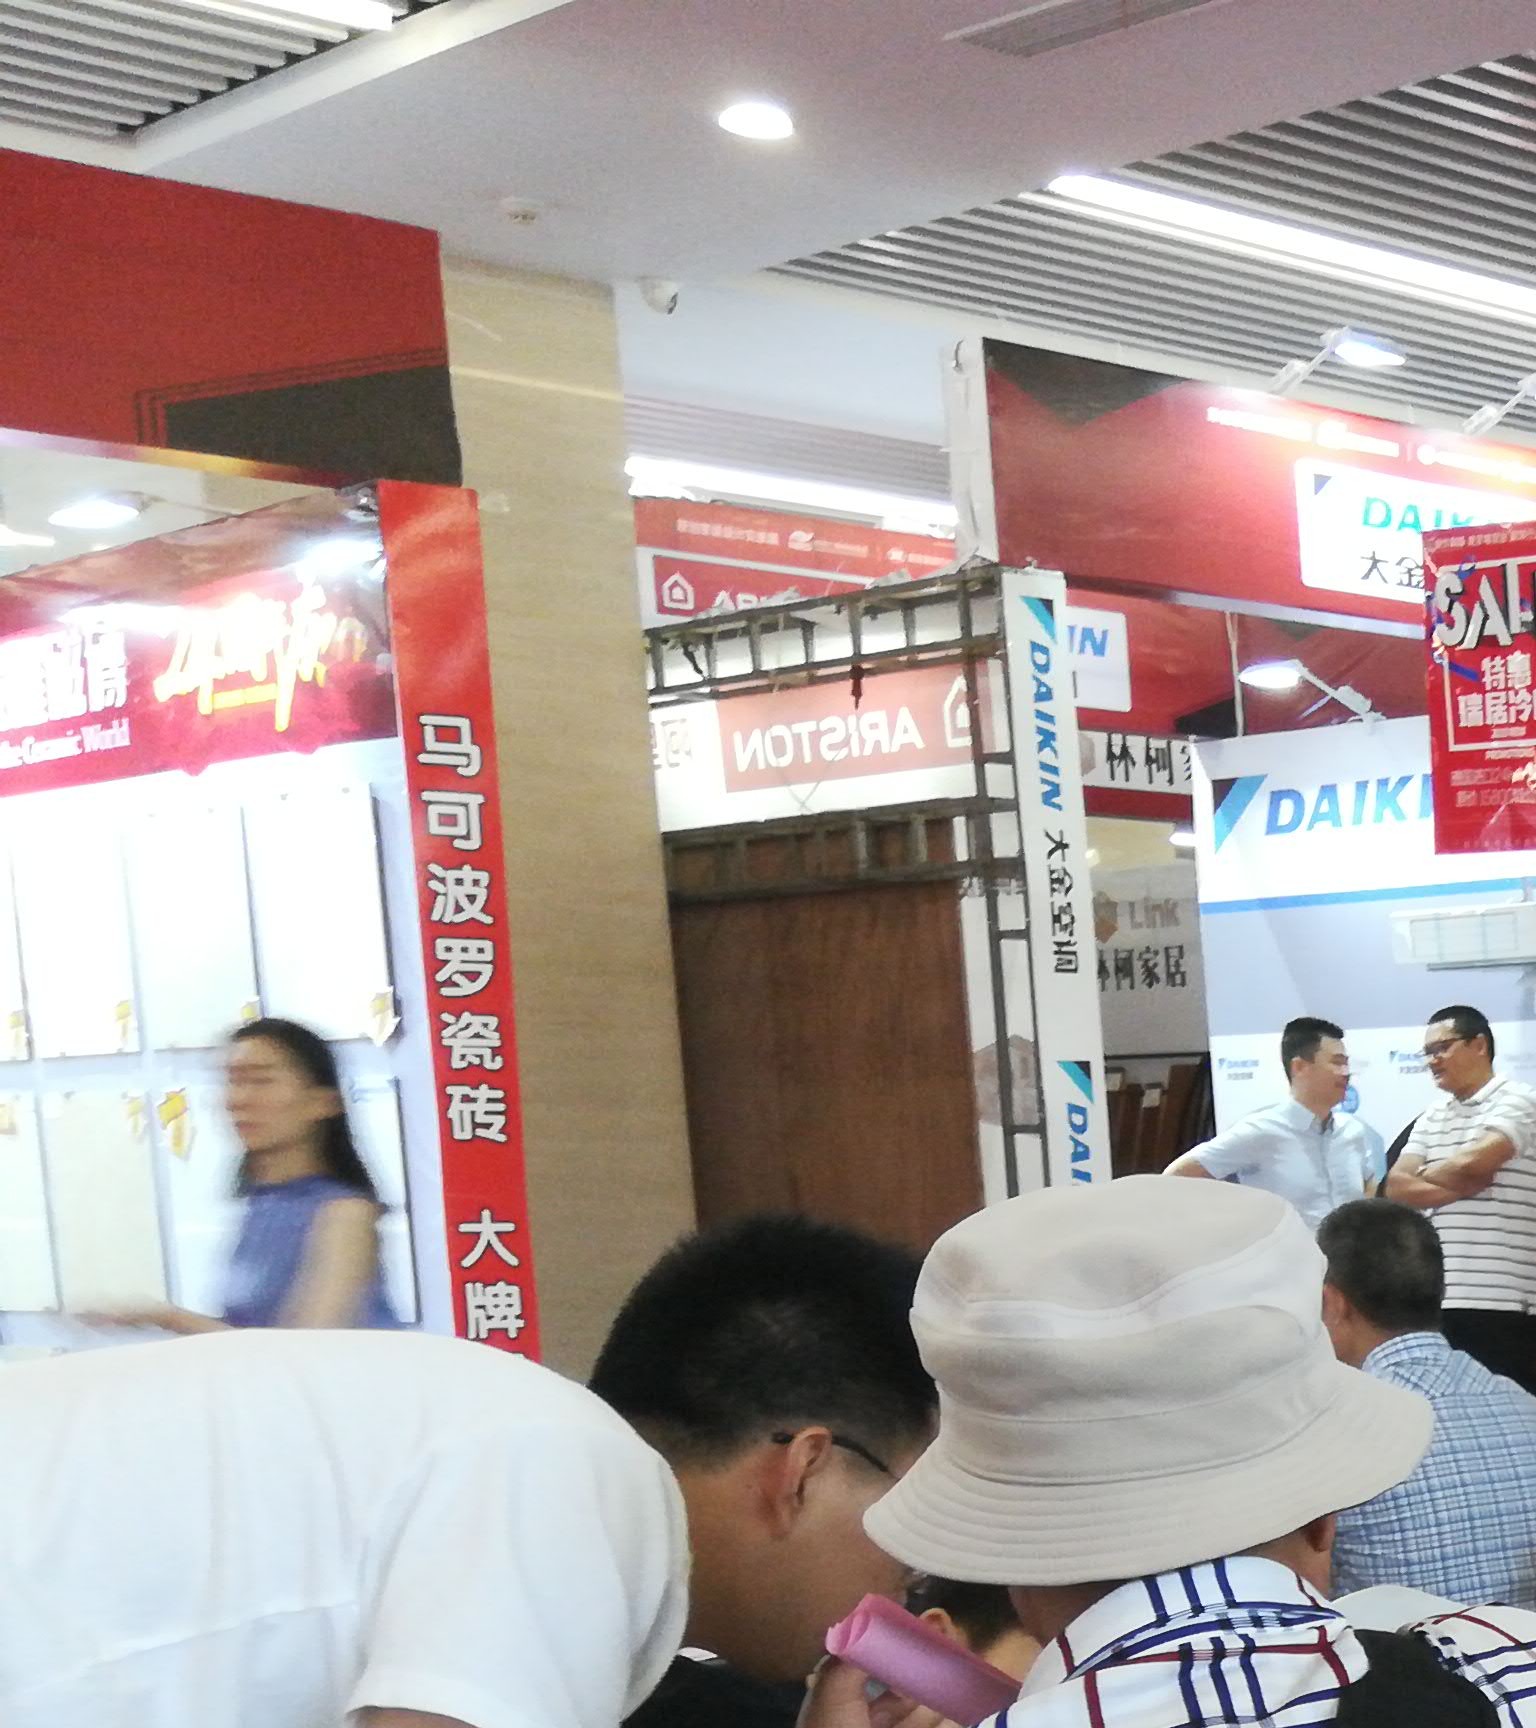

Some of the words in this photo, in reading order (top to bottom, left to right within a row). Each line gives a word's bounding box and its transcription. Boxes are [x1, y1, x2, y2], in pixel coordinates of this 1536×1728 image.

[1030, 640, 1064, 812] DAIKIN
[1481, 650, 1533, 691] 特惠
[416, 713, 509, 1144] 马可波罗瓷砖
[1044, 827, 1079, 975] 大金空调
[457, 1208, 526, 1341] 大牌
